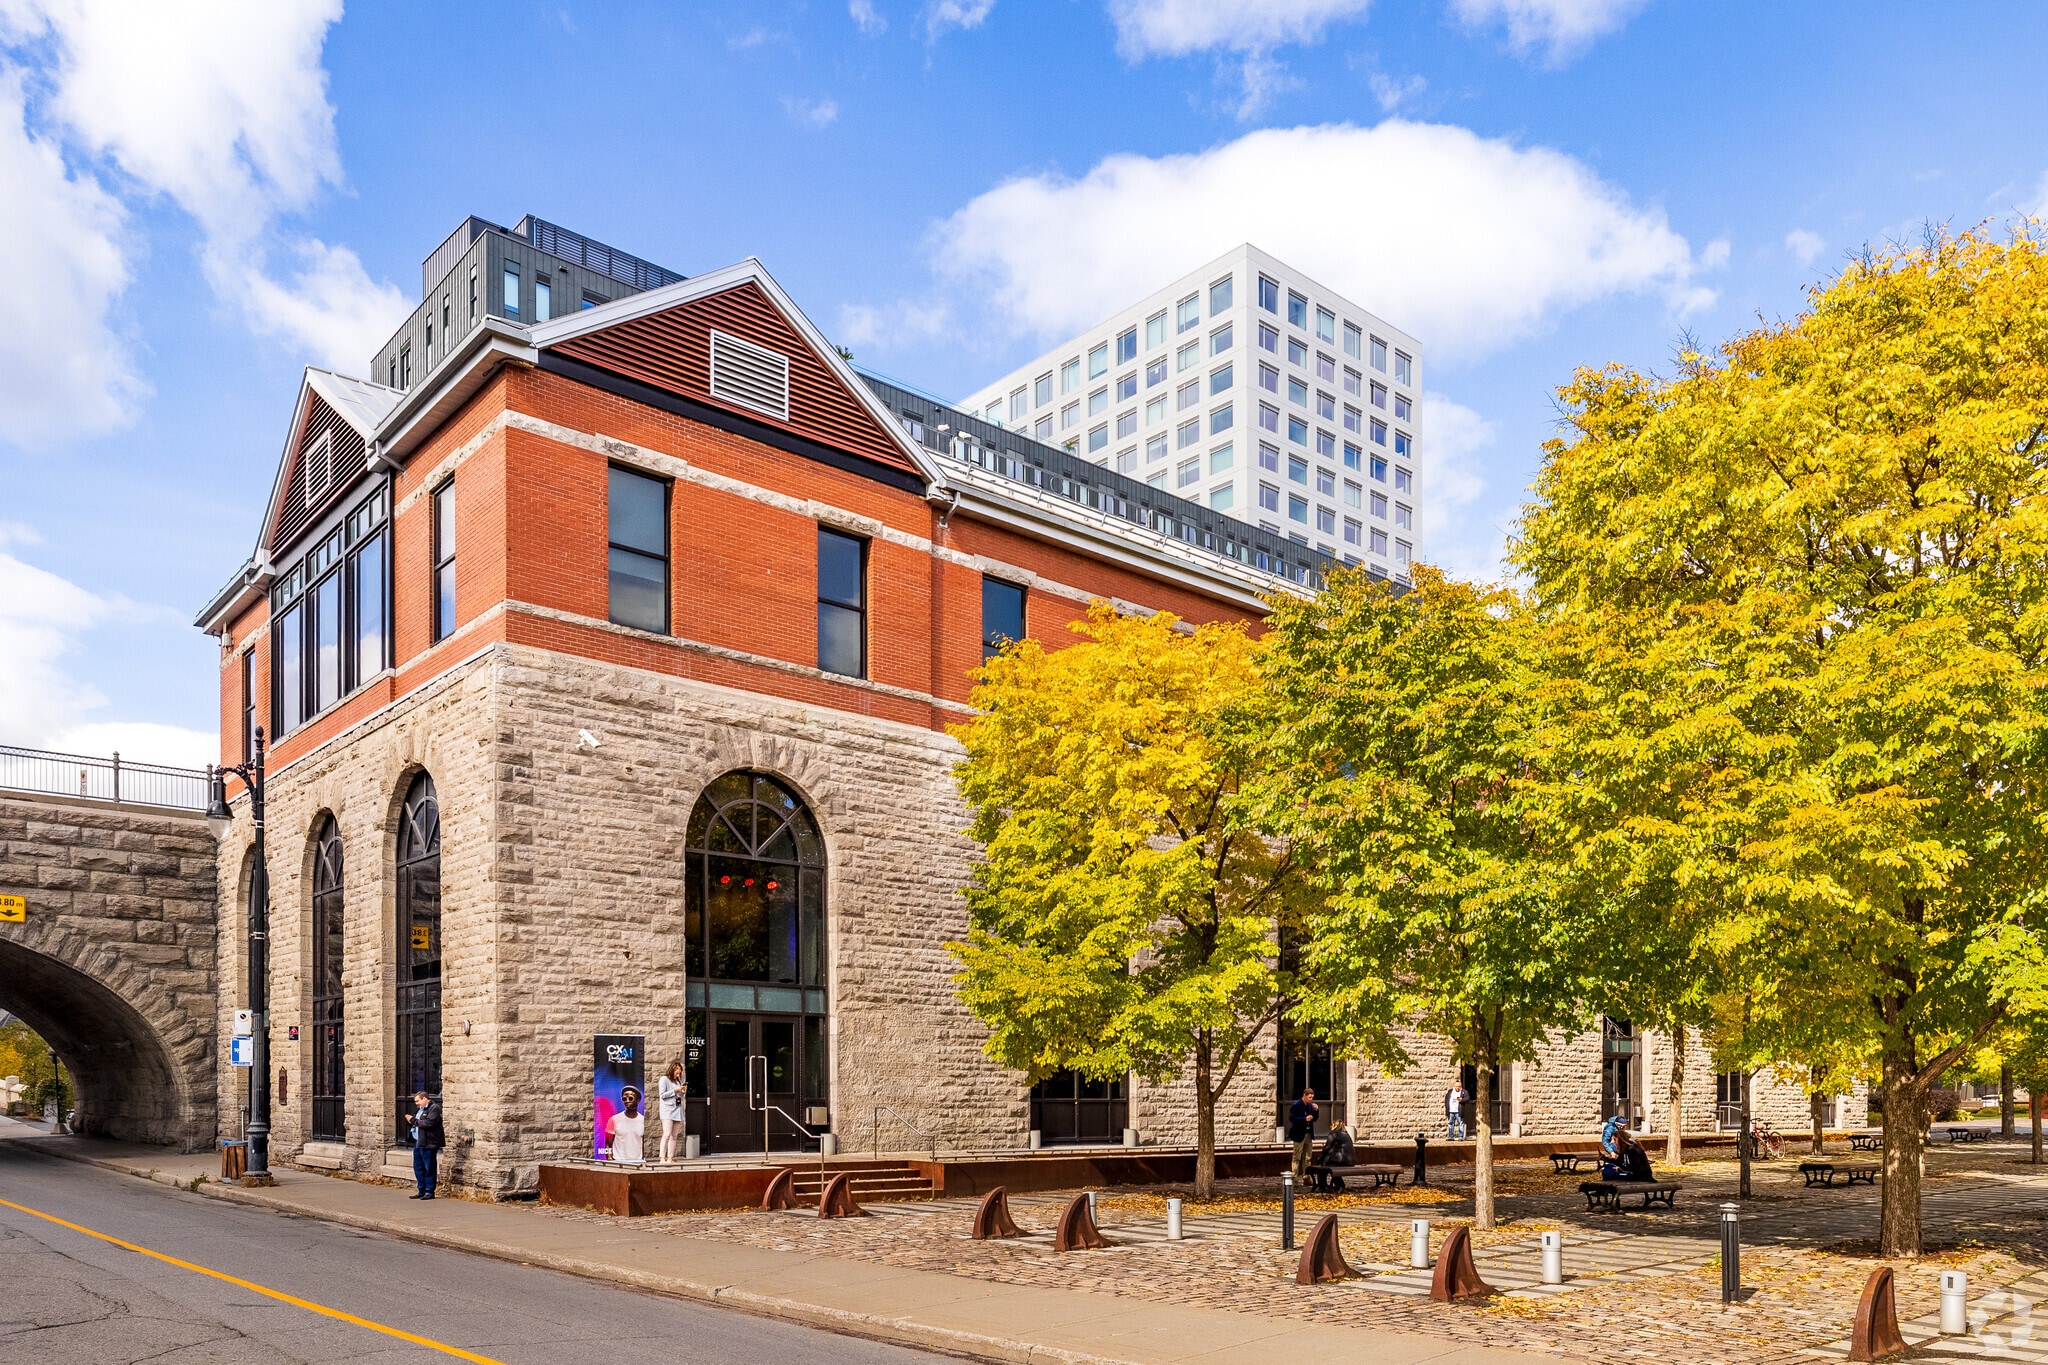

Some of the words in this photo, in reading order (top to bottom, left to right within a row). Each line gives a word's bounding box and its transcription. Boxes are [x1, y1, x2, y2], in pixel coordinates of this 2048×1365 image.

[0, 898, 15, 906] .80
[606, 1044, 624, 1055] CX
[598, 1147, 613, 1155] NICE
